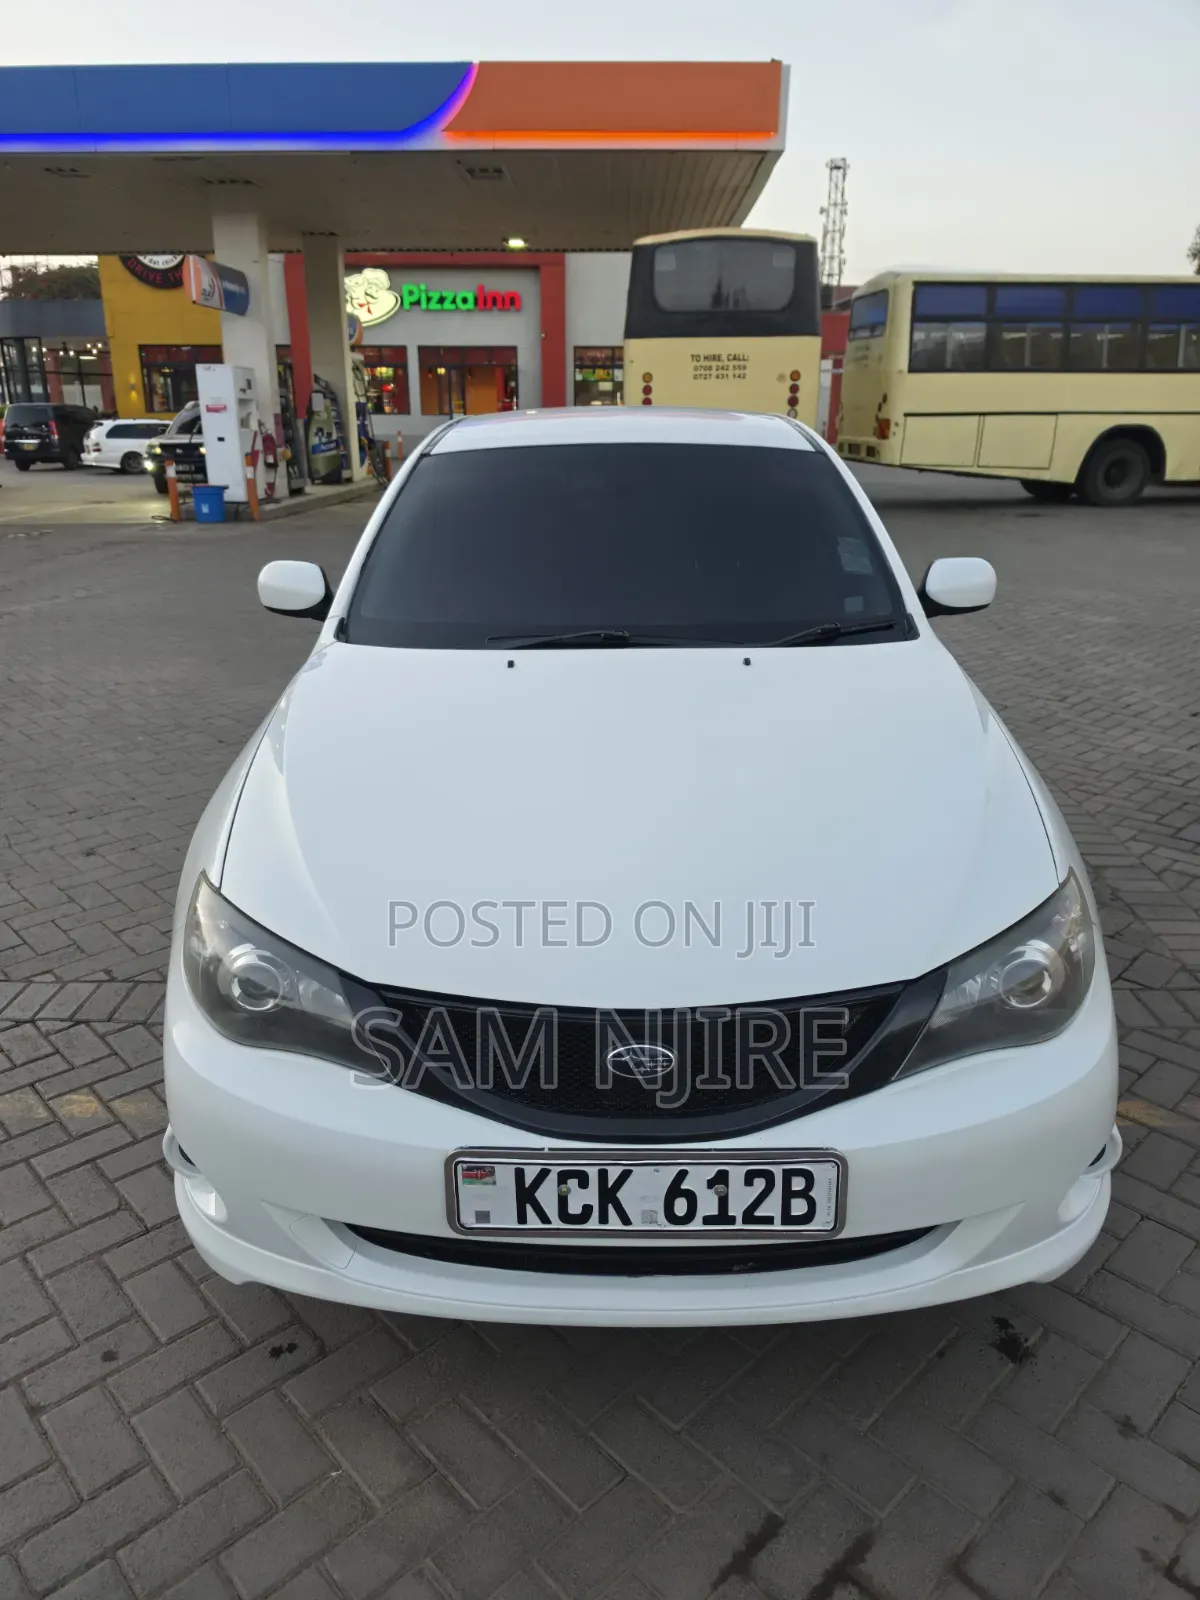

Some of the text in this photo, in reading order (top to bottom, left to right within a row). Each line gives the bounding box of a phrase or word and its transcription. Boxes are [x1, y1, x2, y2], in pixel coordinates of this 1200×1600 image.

[127, 258, 163, 284] DRIVE
[690, 354, 701, 363] TO
[514, 1167, 634, 1226] KCK
[663, 1167, 818, 1226] 612B
